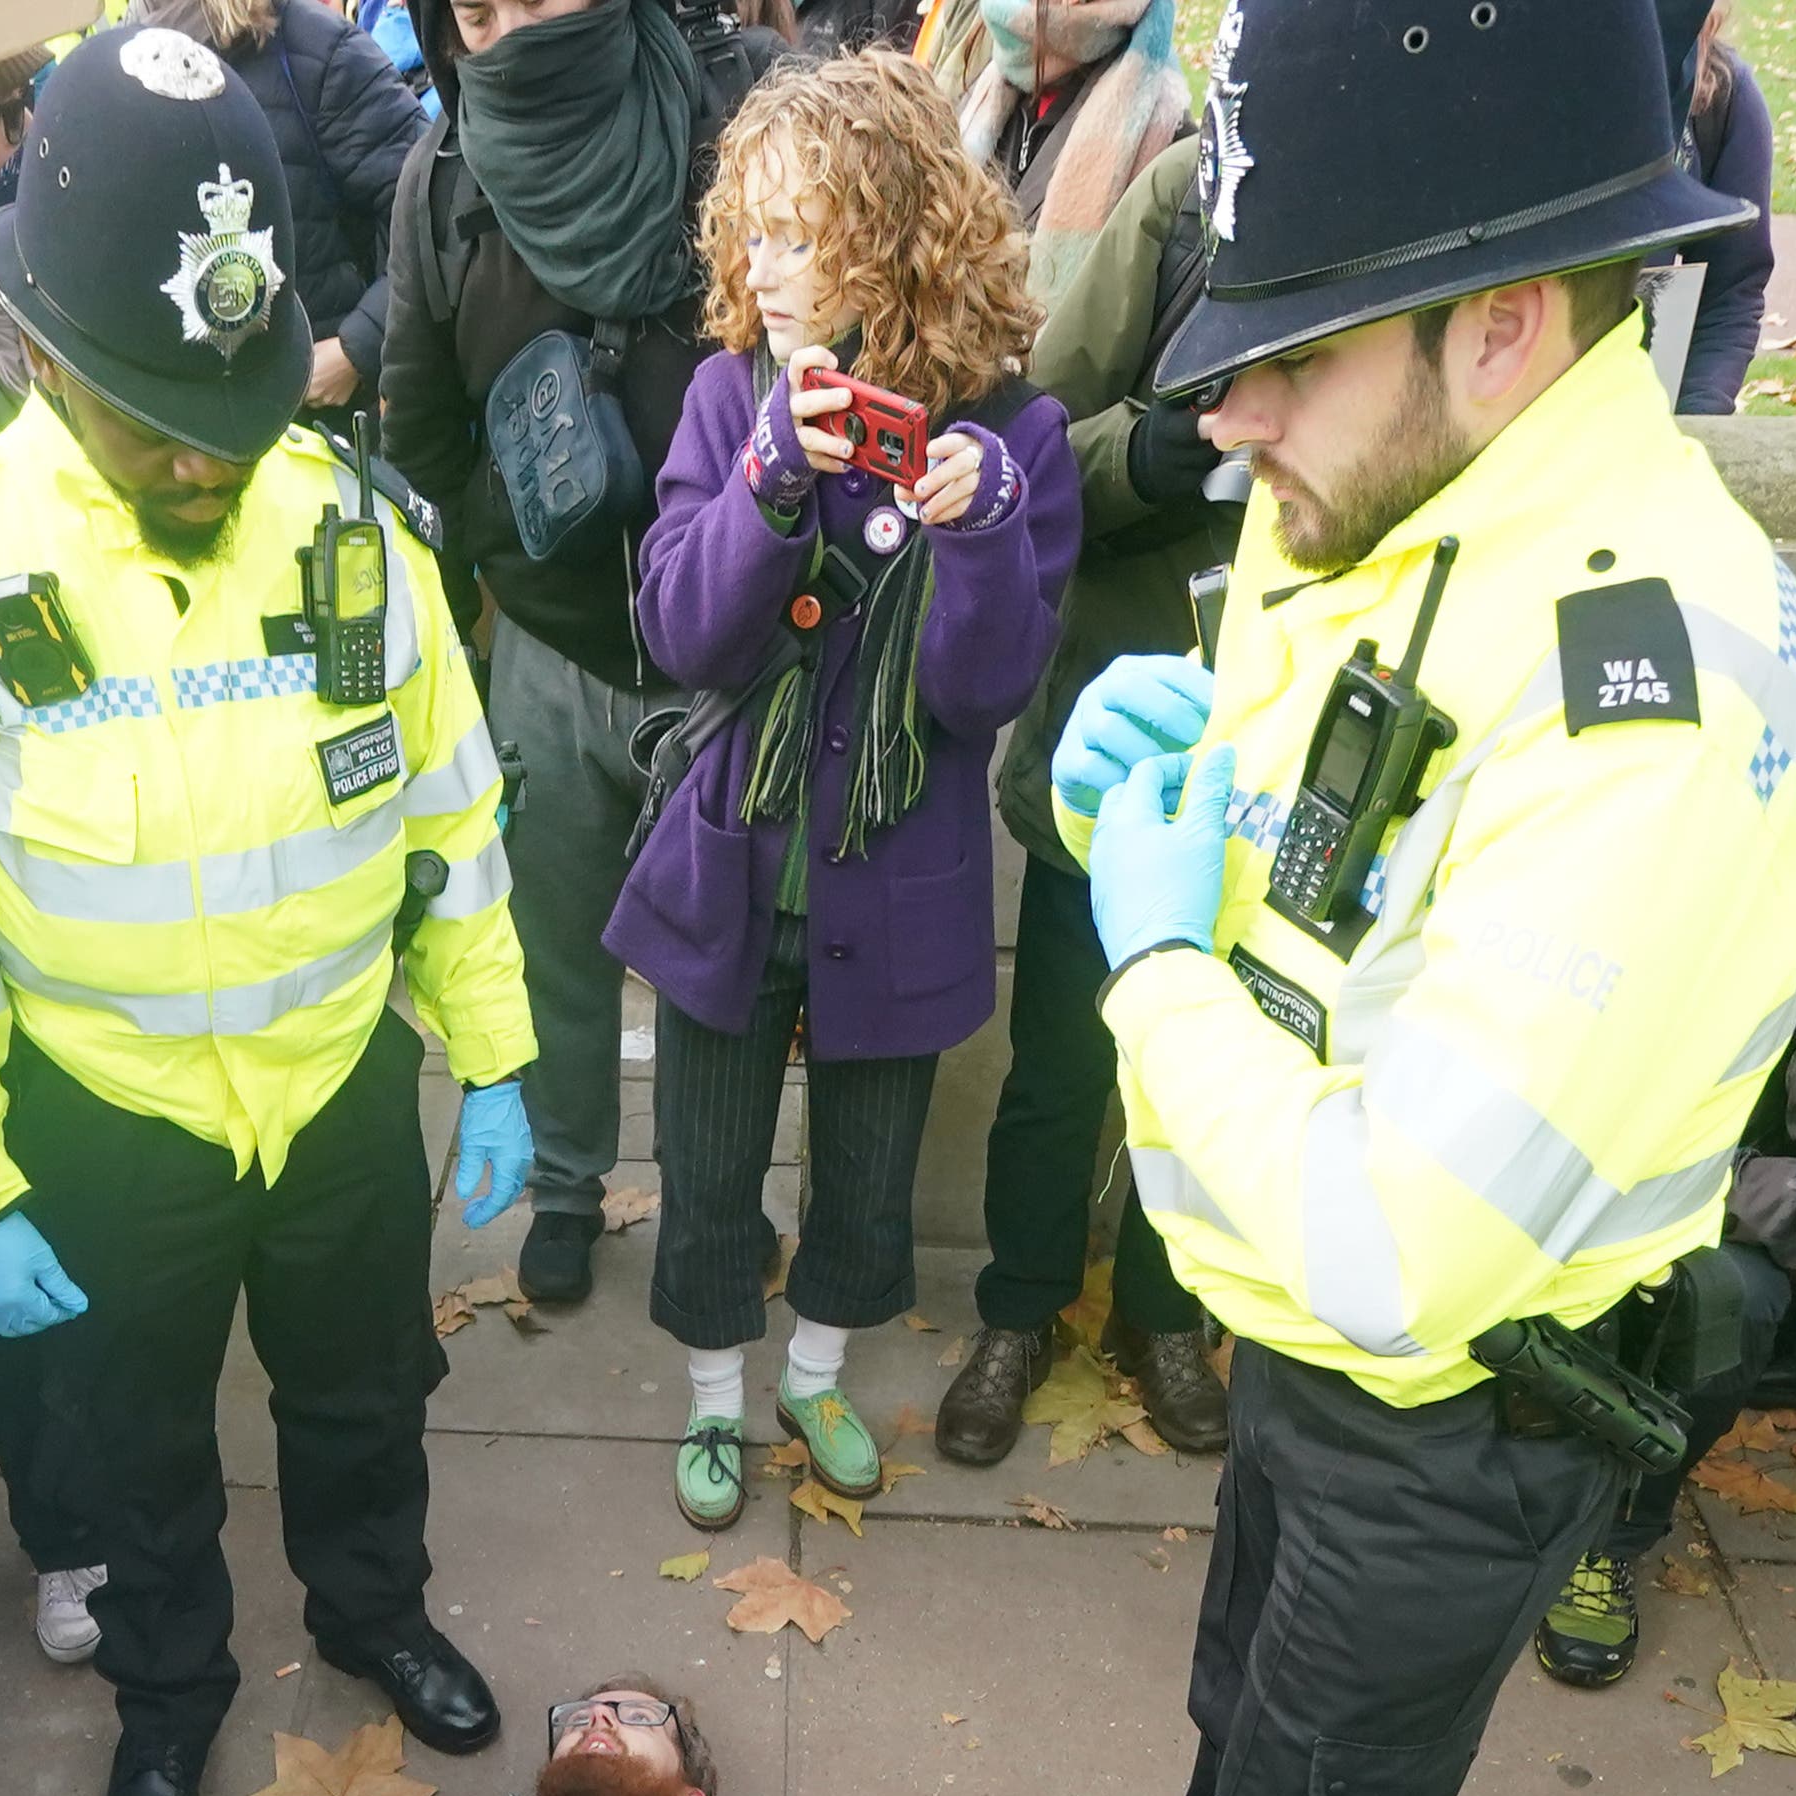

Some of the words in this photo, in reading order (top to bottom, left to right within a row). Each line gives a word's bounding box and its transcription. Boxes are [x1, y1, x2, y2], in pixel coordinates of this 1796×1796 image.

[1602, 658, 1658, 682] WA
[1598, 681, 1671, 708] 2745
[358, 740, 392, 763] POLICE
[332, 769, 369, 797] POLICE
[1469, 920, 1624, 1014] POLICE
[1257, 978, 1316, 1026] METROPOLITAN
[1261, 998, 1309, 1034] POLICE
